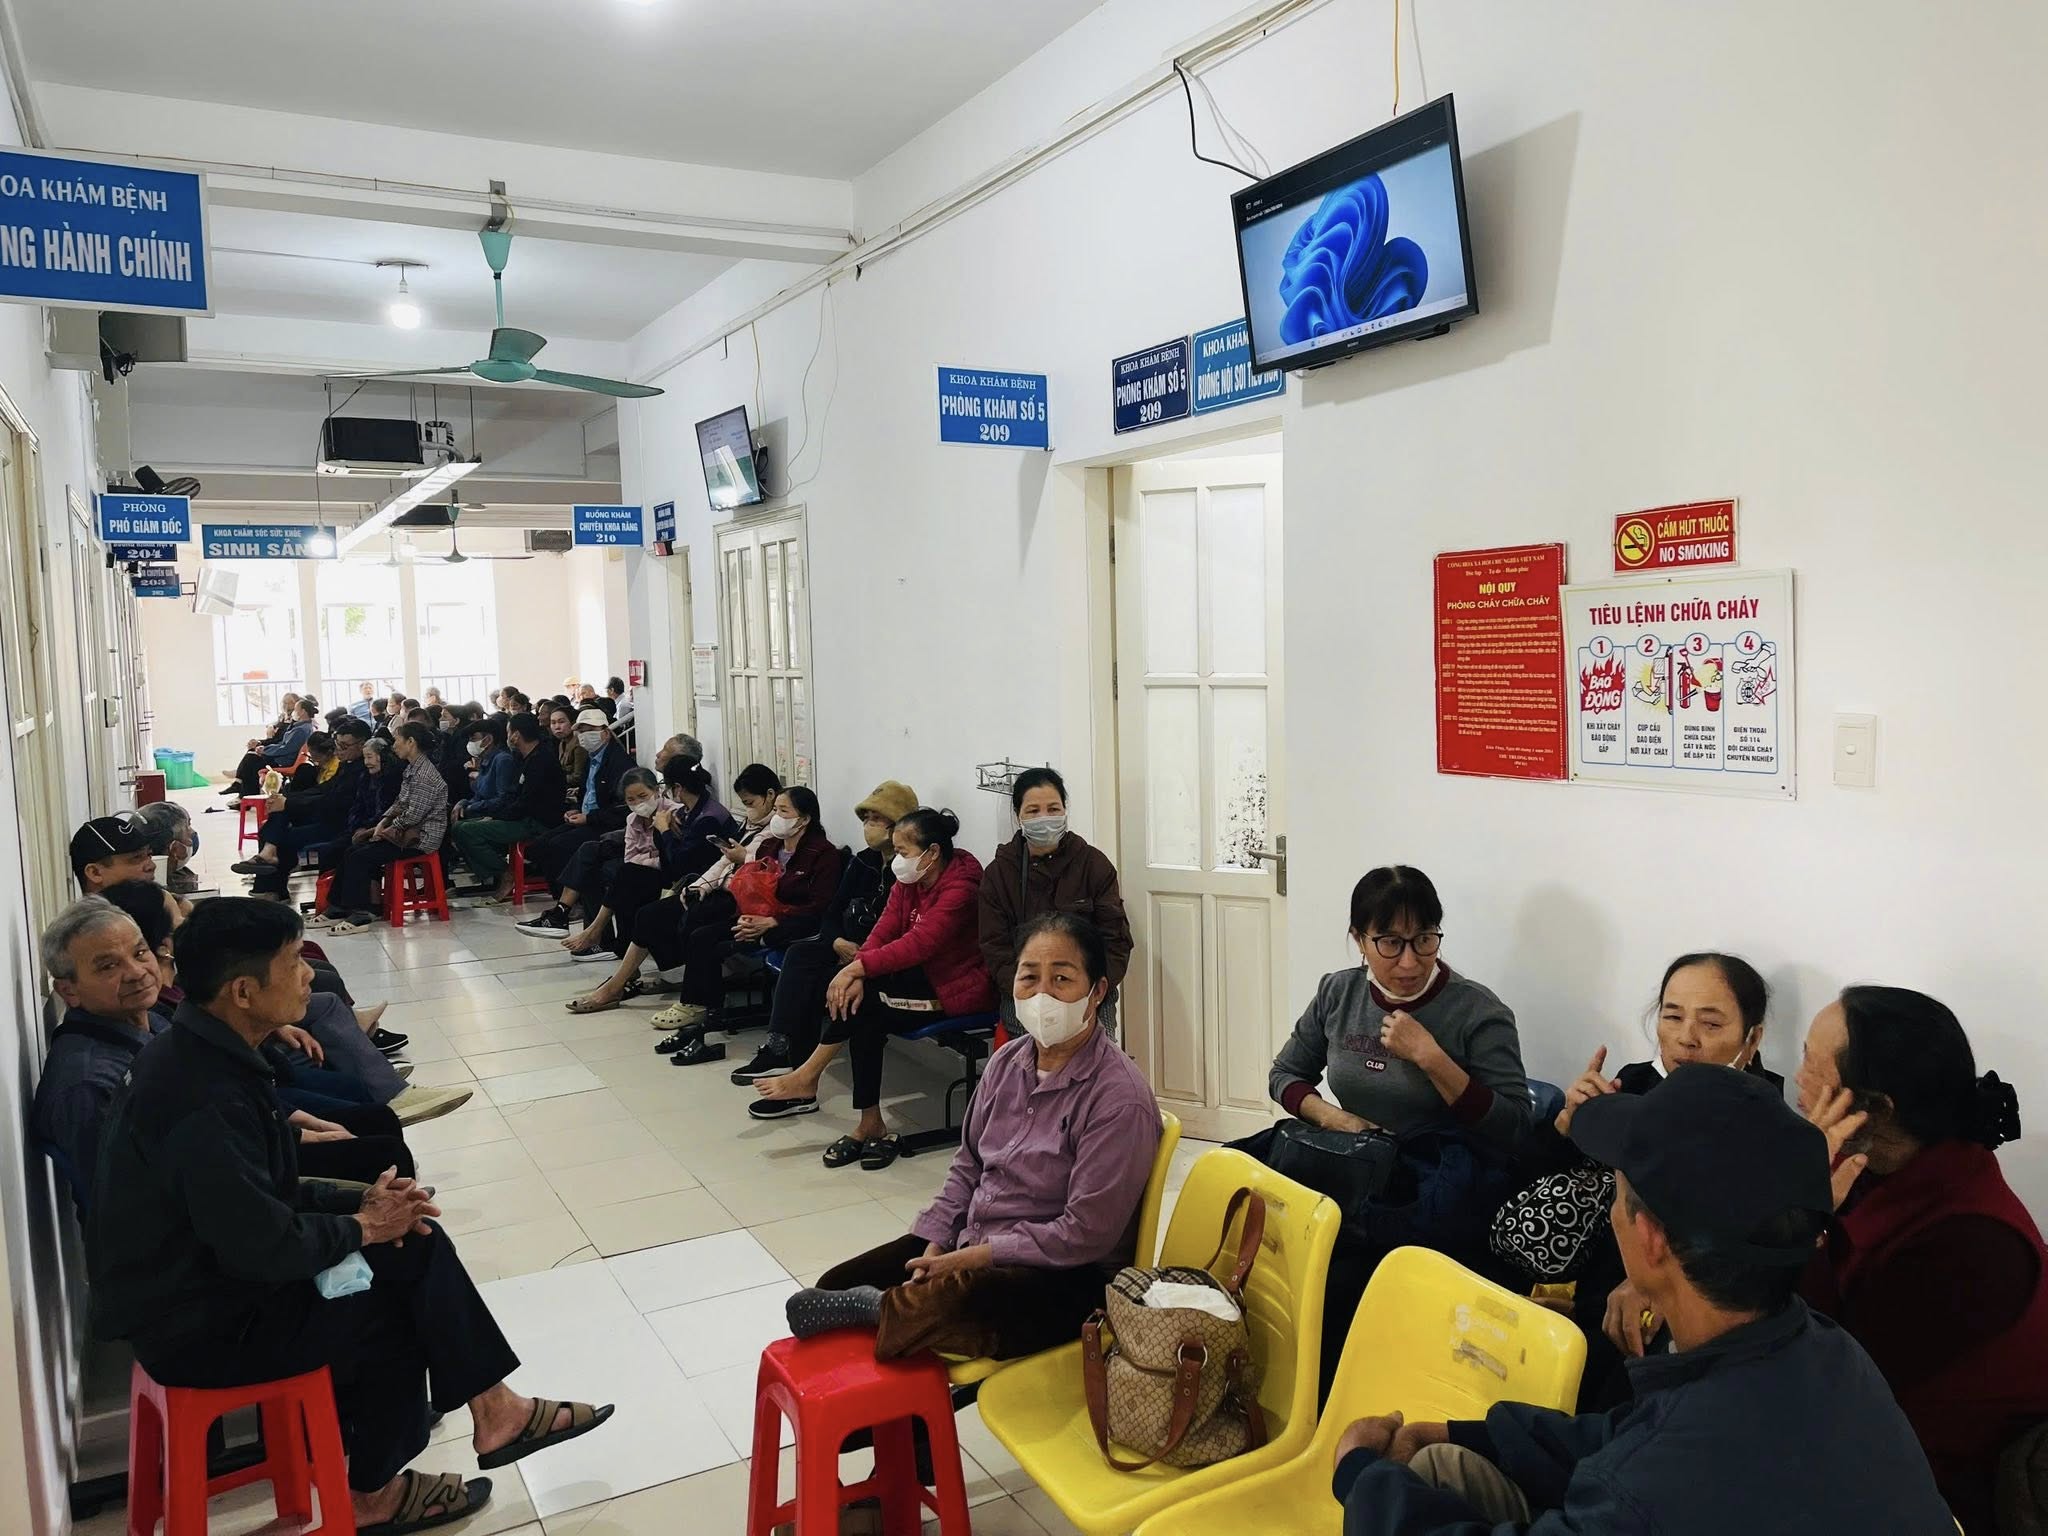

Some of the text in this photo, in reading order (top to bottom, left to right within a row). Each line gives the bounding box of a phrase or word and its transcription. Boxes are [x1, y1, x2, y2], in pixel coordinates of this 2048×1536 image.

[41, 177, 106, 206] KHÁM
[111, 182, 168, 215] BỆNH
[43, 222, 112, 275] HÀNH
[118, 230, 193, 282] CHÍNH
[1203, 337, 1225, 358] KHOA
[1121, 347, 1180, 375] KHOA KHÁM BỆNH
[949, 374, 1037, 390] KHOA KHÁM BỆNH
[1117, 363, 1186, 408] PHÒNG KHÁM SỐ 5
[1234, 362, 1246, 392] SOI
[941, 392, 1045, 421] PHÒNG KHÁM SỐ 5
[1140, 401, 1162, 423] 209
[979, 423, 1011, 441] 209
[122, 500, 167, 513] PHÒNG
[109, 516, 182, 534] PHÓ GIÁM ĐỐC
[604, 522, 621, 532] KHOA
[1657, 508, 1729, 539] CẤM HÚT THUỐC
[213, 528, 233, 538] KHOA
[595, 533, 617, 543] 210
[127, 548, 164, 559] 204
[208, 542, 260, 556] SINH
[1659, 541, 1729, 563] NO SMOKING
[1479, 581, 1516, 596] NỘI QUY
[1447, 594, 1551, 610] PHÒNG CHÁY CHỮA CHÁY
[1589, 595, 1760, 627] TIÊU LỆNH CHỮA CHÁY
[1597, 640, 1604, 654] 1
[1644, 638, 1653, 653] 2
[1693, 637, 1702, 652] 3
[1744, 635, 1754, 650] 4
[1589, 673, 1612, 690] BÁO
[1585, 689, 1620, 712] ĐỘNG
[1366, 1060, 1385, 1070] CLUB
